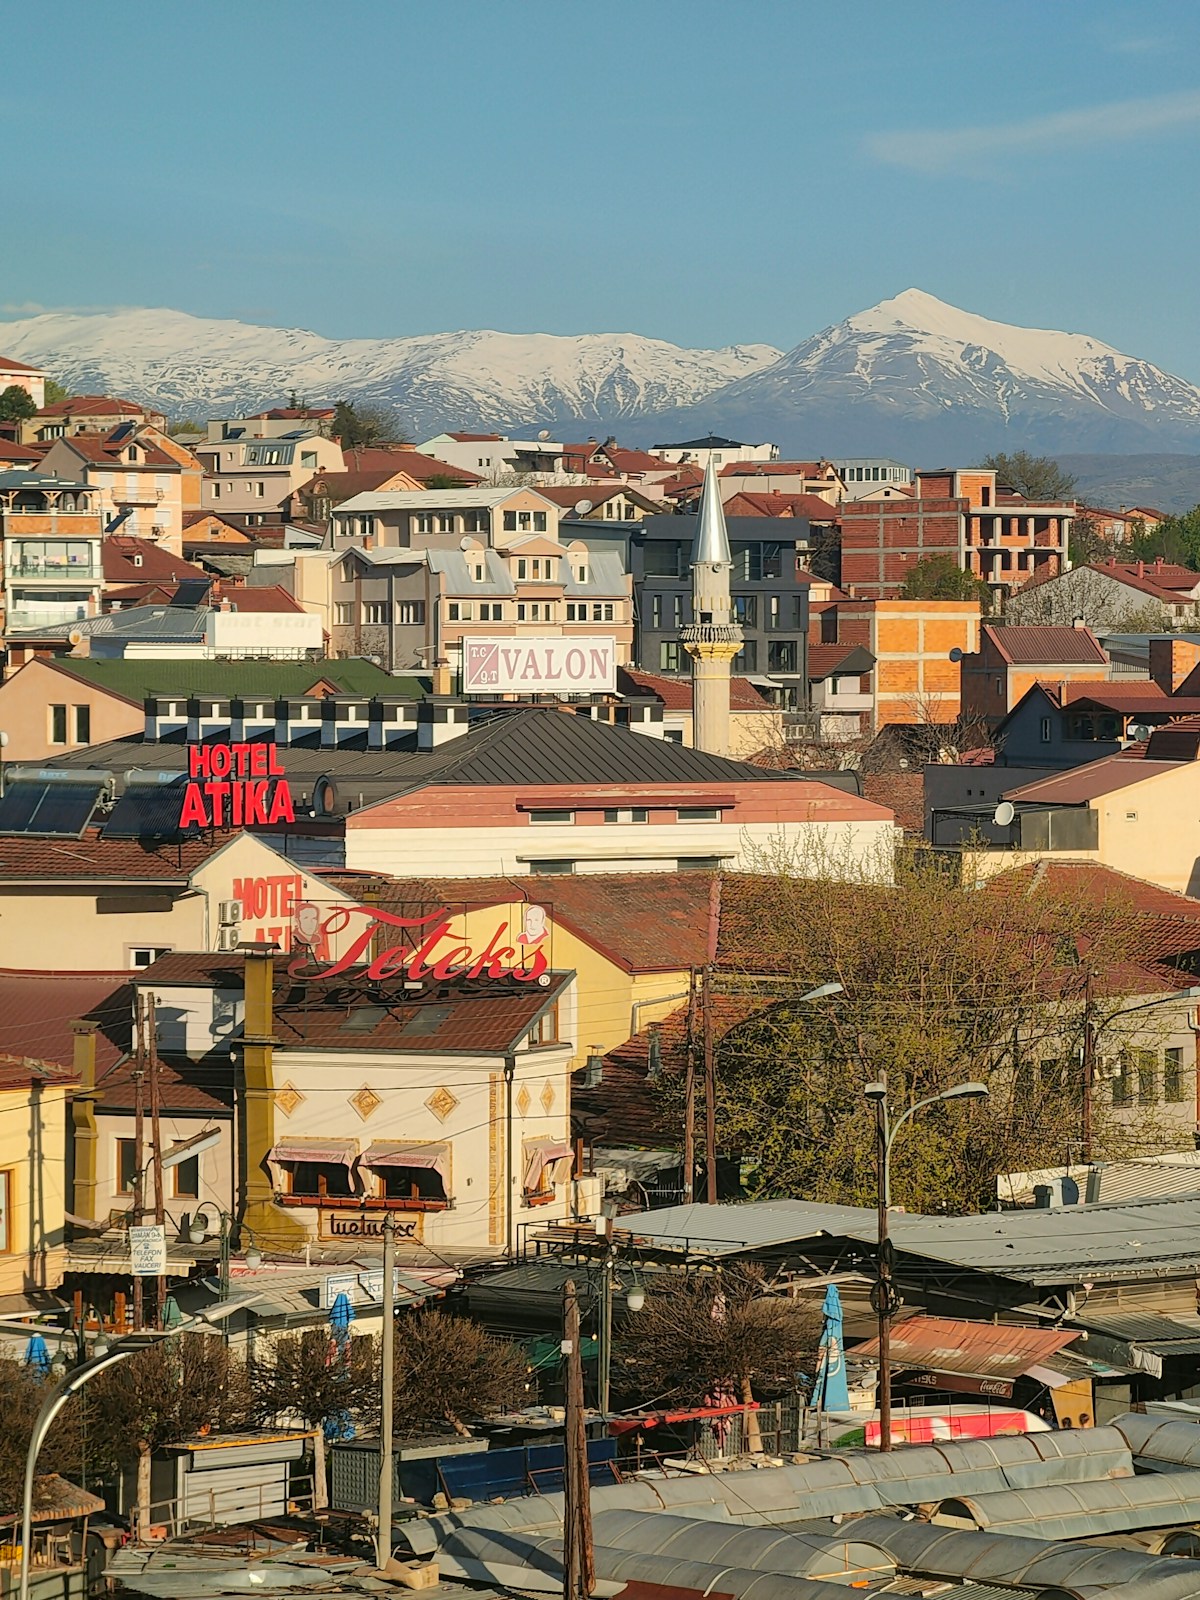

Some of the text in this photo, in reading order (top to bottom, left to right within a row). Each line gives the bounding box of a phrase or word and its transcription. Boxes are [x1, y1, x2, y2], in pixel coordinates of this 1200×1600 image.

[500, 648, 609, 680] VALON
[189, 743, 285, 778] HOTEL
[179, 780, 296, 828] ATIKA
[255, 923, 330, 961] TIA
[287, 906, 548, 981] Teteks
